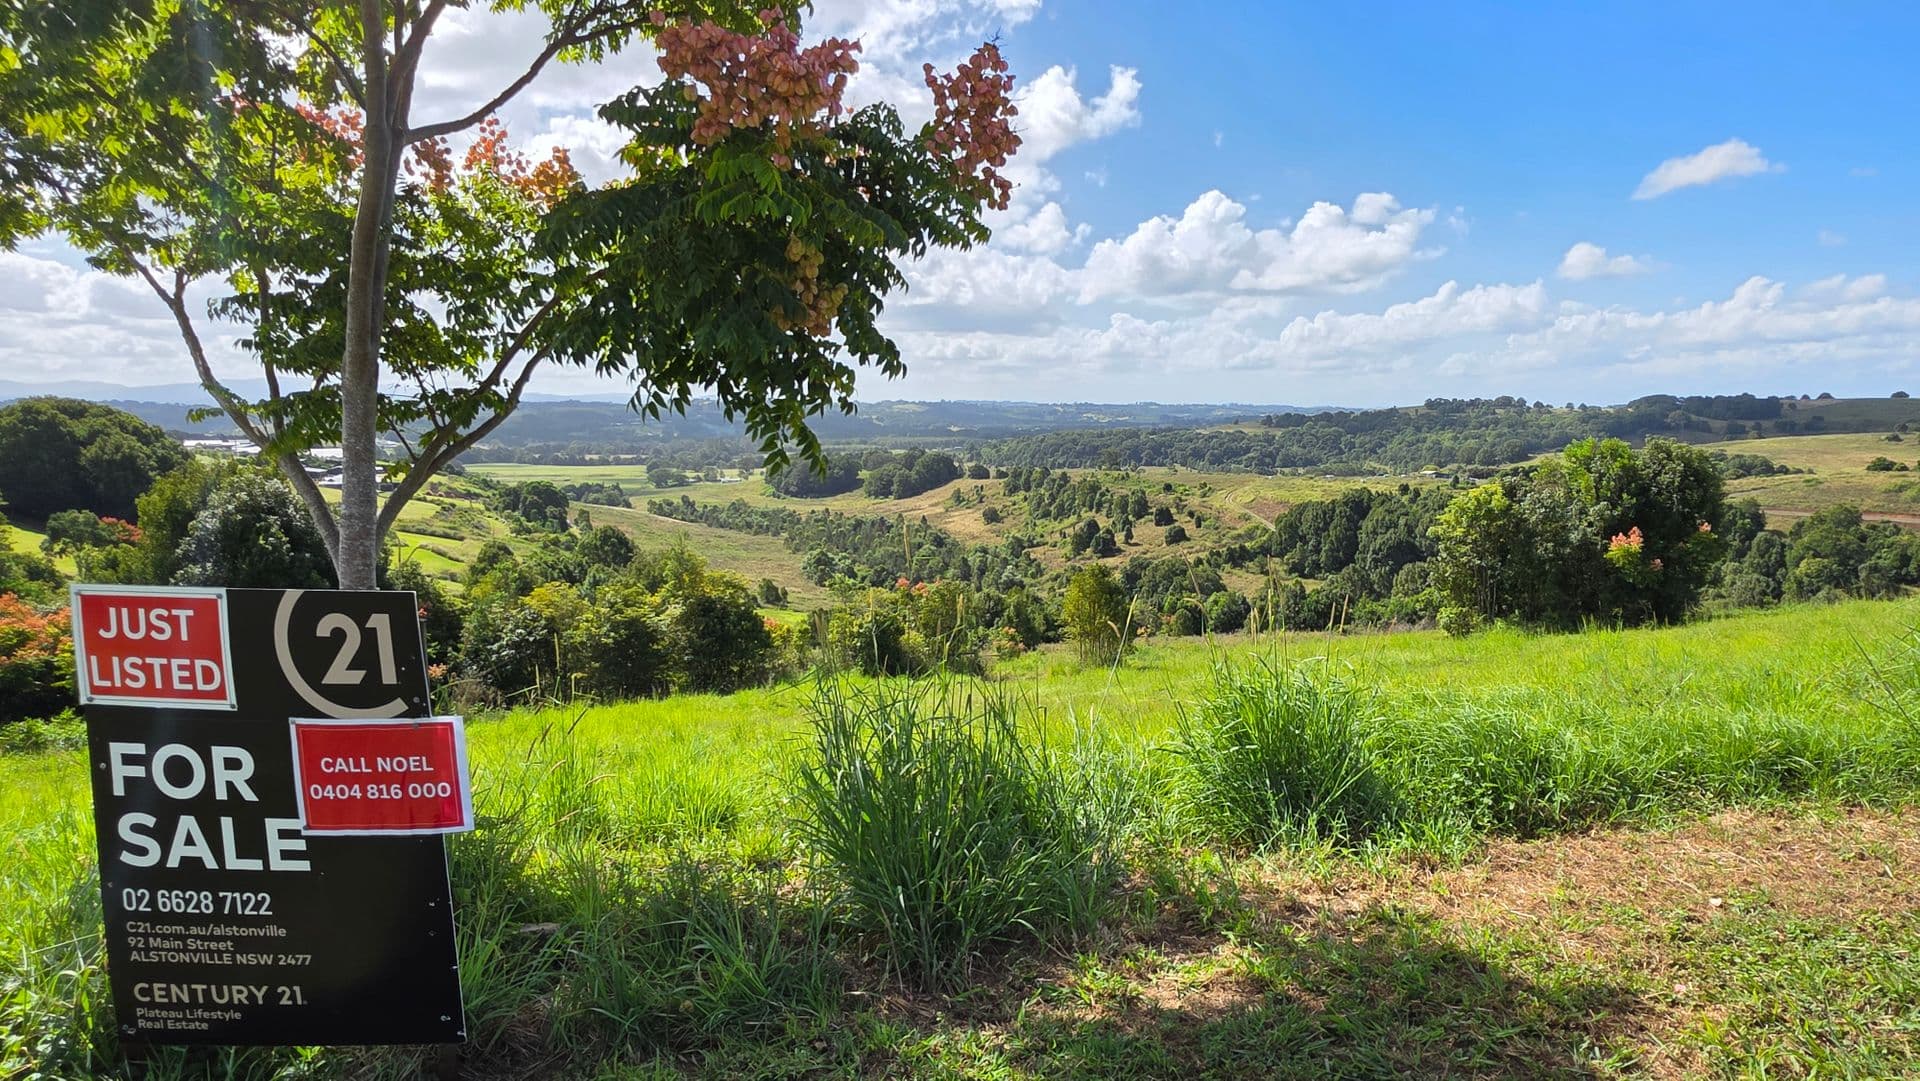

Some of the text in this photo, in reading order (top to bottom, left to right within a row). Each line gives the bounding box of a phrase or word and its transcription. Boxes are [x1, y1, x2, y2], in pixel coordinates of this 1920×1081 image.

[98, 607, 194, 642] JUST
[89, 655, 222, 692] LISTED
[108, 741, 260, 803] FOR
[320, 756, 434, 773] CALL NOEL
[310, 782, 452, 800] 0404 816 000
[117, 811, 312, 873] SALE
[122, 887, 273, 916] 02 6628 7122
[126, 921, 287, 937] C21.com.au/alstonville
[127, 936, 235, 951] 92 Main Street
[130, 950, 313, 966] ALSTONVILLE NSW 2477
[133, 982, 270, 1006] CENTURY
[135, 1007, 243, 1022] Plateau Lifestyle
[137, 1019, 210, 1031] Real Estate
